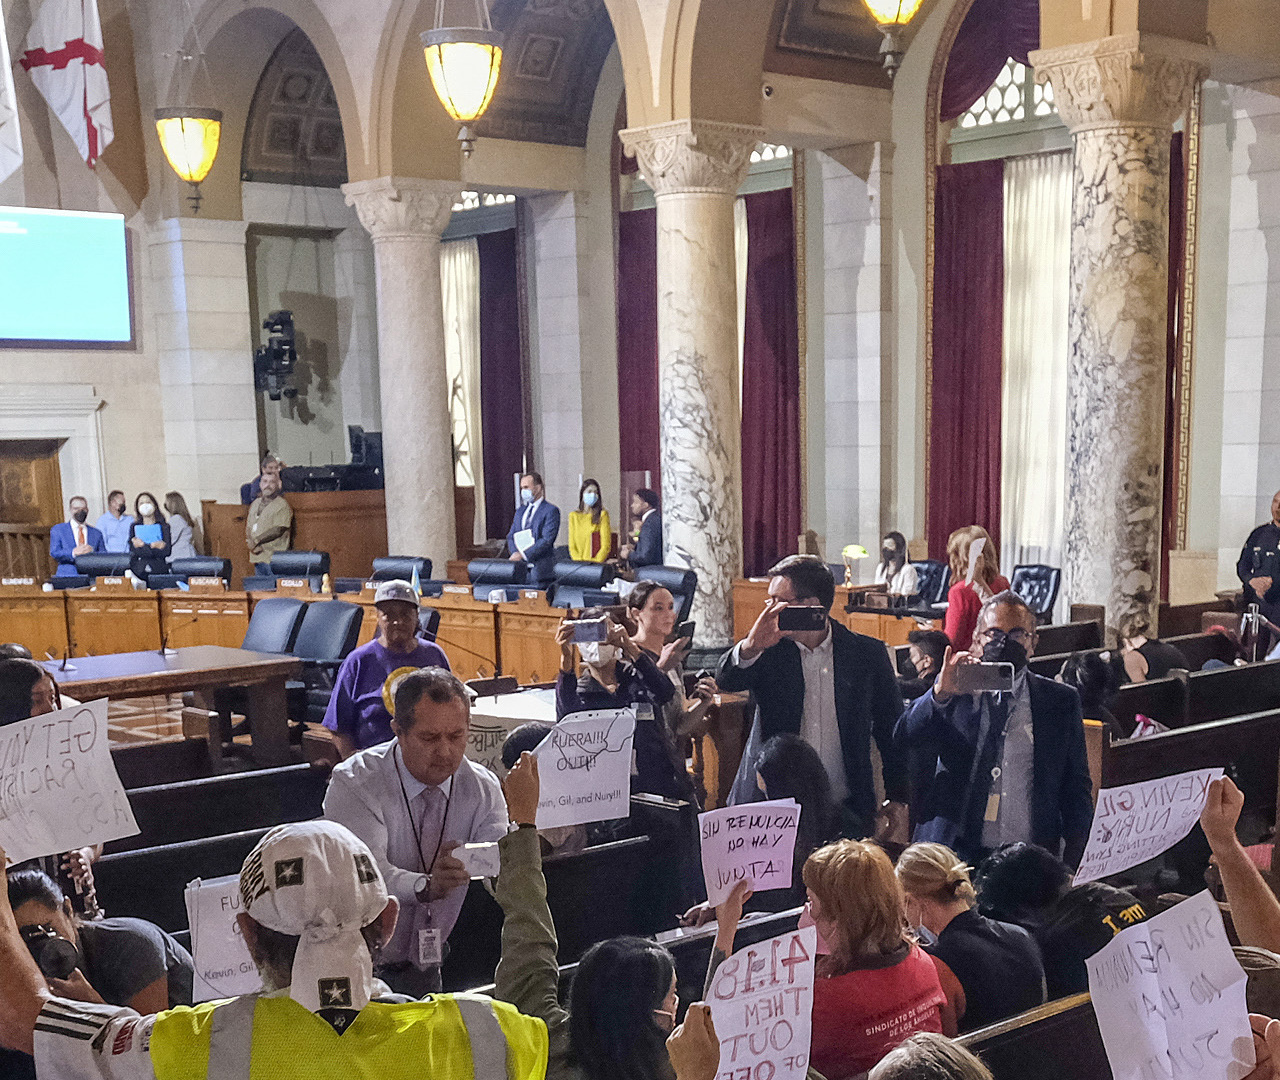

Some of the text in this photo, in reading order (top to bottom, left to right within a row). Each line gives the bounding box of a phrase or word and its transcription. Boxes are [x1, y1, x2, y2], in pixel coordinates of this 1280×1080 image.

[576, 792, 592, 803] and
[702, 820, 719, 839] SIN
[728, 834, 782, 853] NO HAY
[715, 860, 779, 889] JUNTA
[865, 1014, 908, 1036] SINDICATO
